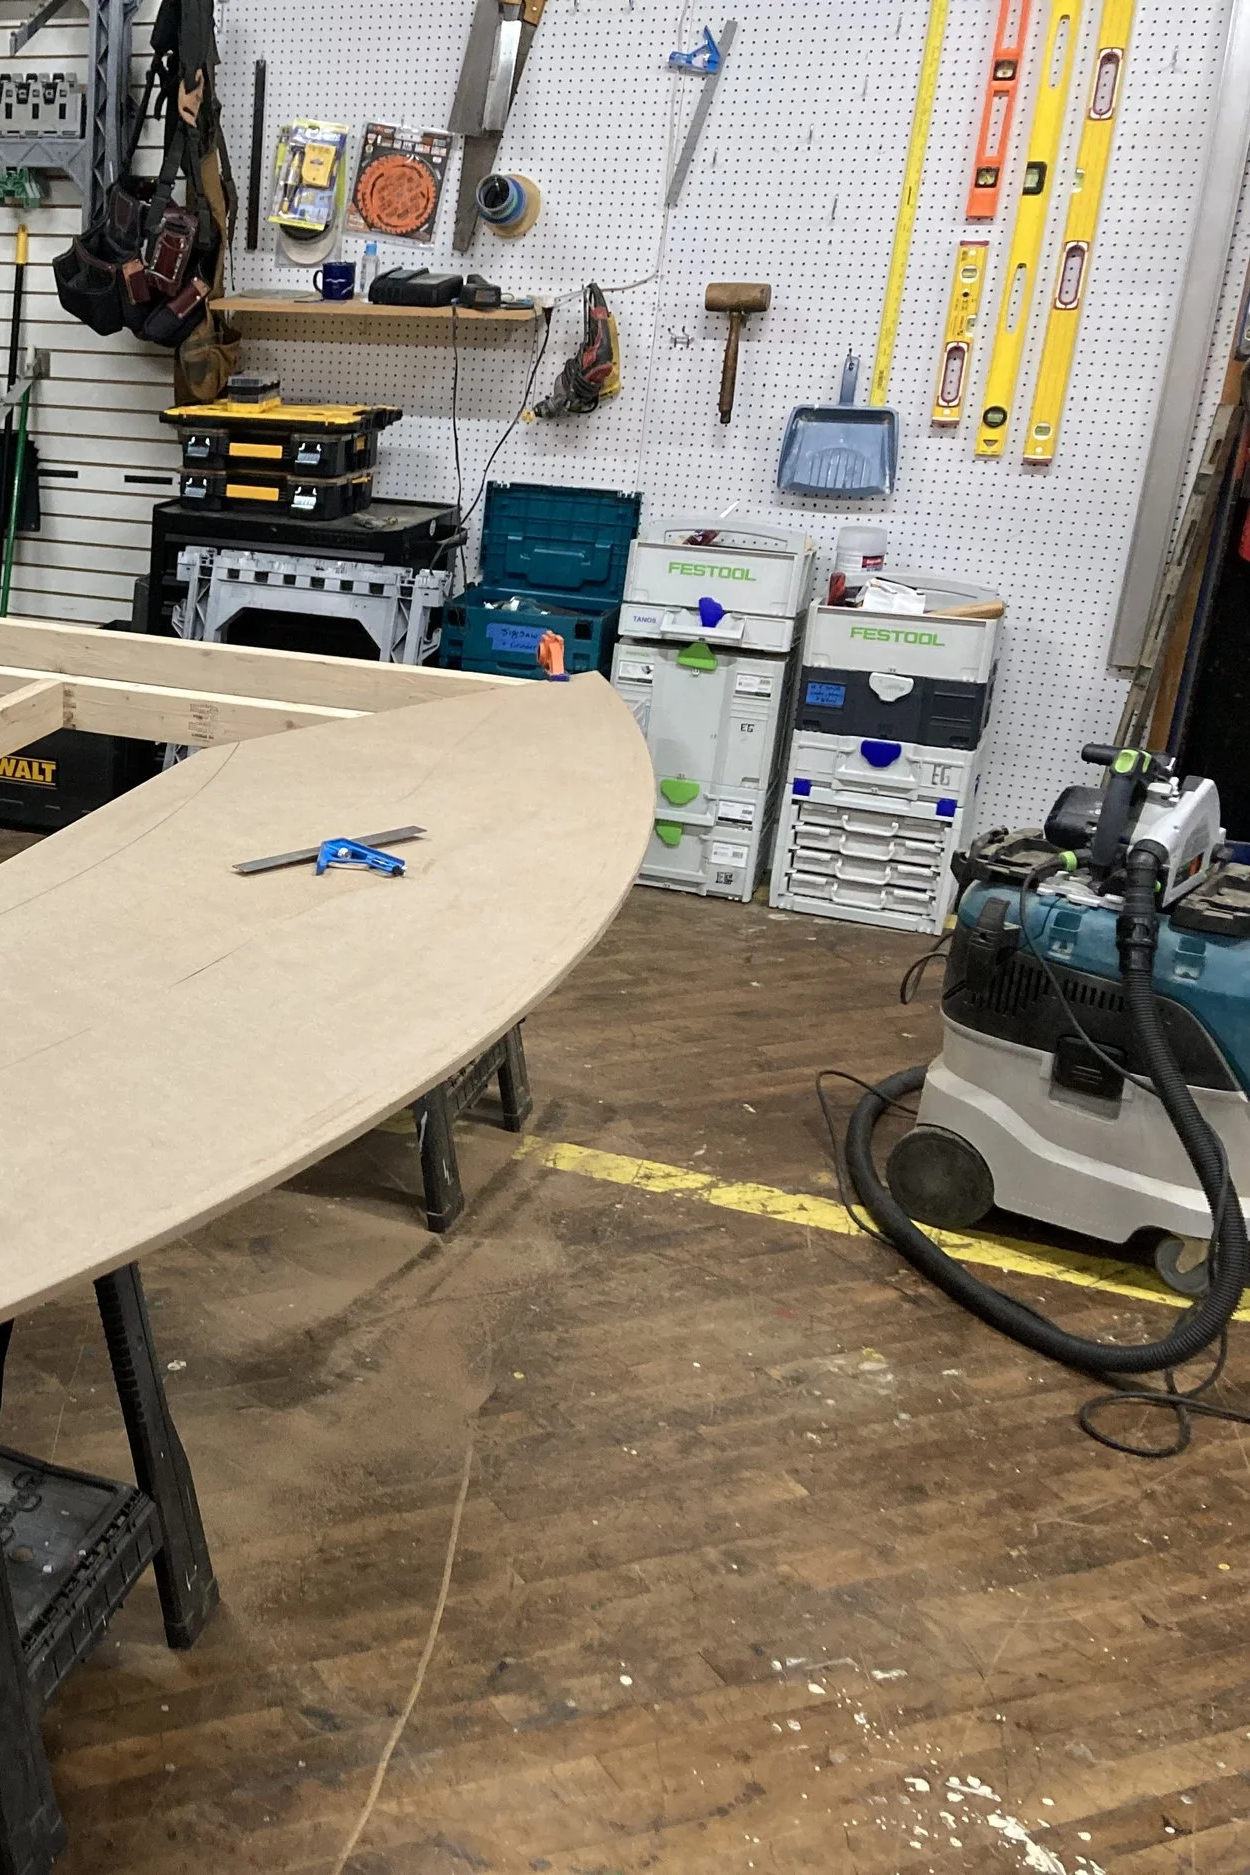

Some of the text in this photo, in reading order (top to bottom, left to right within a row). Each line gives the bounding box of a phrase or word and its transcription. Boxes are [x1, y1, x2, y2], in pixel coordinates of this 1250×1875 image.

[668, 562, 756, 581] FESTOOL
[633, 615, 657, 624] TANOS
[850, 626, 945, 647] FESTOOL
[740, 723, 755, 733] EG
[931, 763, 950, 786] EG
